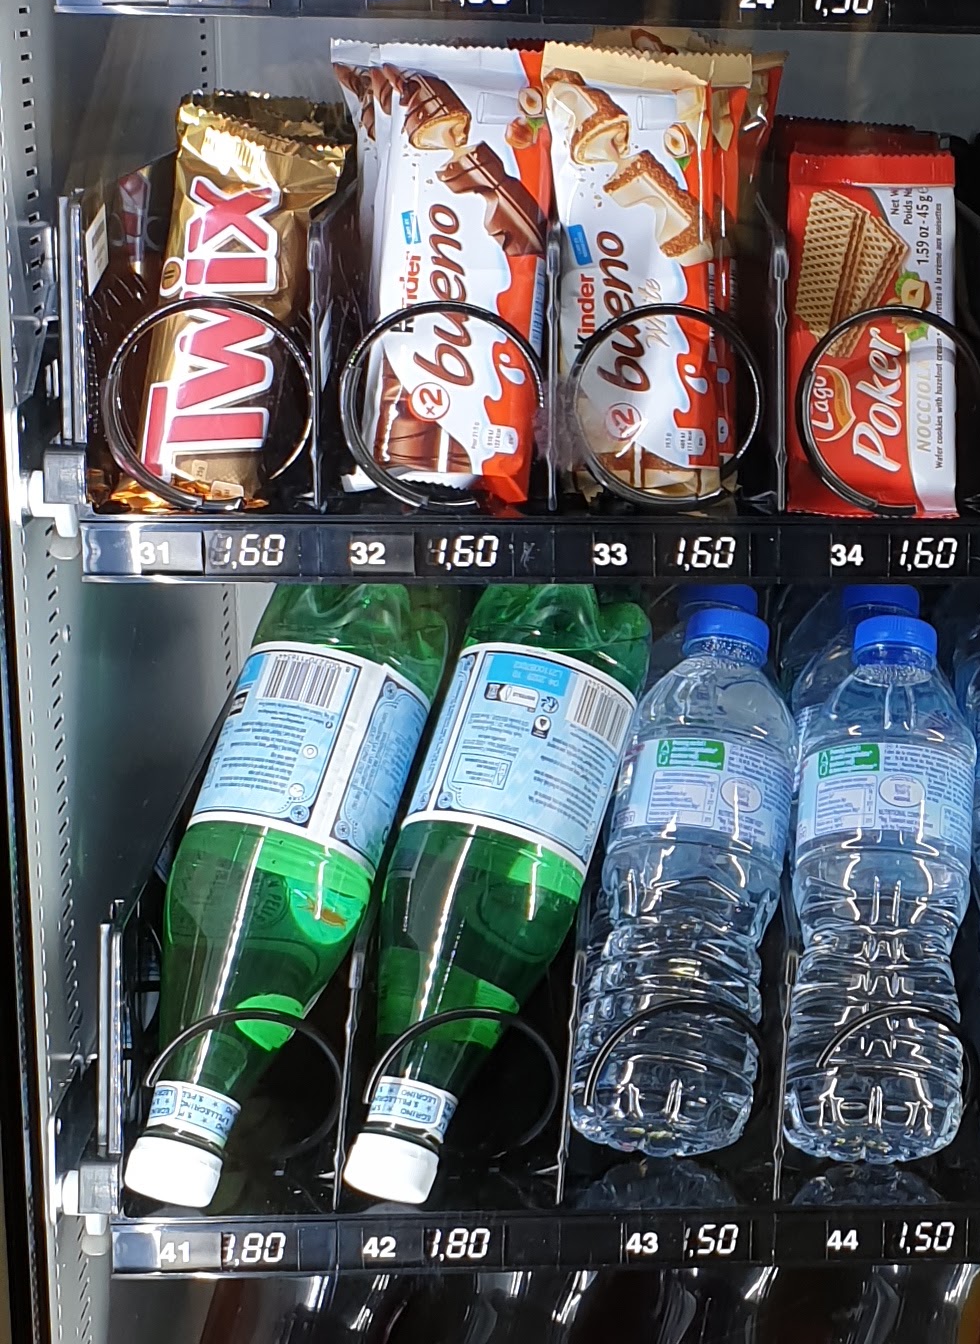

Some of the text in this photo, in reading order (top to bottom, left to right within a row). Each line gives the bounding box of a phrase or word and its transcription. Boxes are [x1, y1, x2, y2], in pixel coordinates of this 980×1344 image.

[904, 200, 913, 224] Poids
[935, 203, 943, 235] noisettes
[916, 204, 929, 264] 1.59 oz 45
[413, 203, 475, 387] bueno
[597, 231, 651, 391] bueno
[144, 177, 284, 478] Twix
[853, 327, 905, 472] Poker
[935, 364, 943, 444] cookies hazelnut
[139, 541, 170, 565] 31
[222, 534, 287, 569] 1,60
[350, 541, 386, 565] 32
[593, 544, 628, 566] 33
[676, 536, 736, 571] 1,60
[830, 544, 864, 566] 34
[900, 538, 958, 571] 1,60
[161, 1242, 191, 1264] 41
[362, 1236, 397, 1258] 42
[429, 1227, 490, 1260] 1,80
[626, 1232, 660, 1254] 43
[683, 1223, 739, 1257] 1,50
[826, 1229, 860, 1251] 44
[899, 1221, 955, 1254] 1,50
